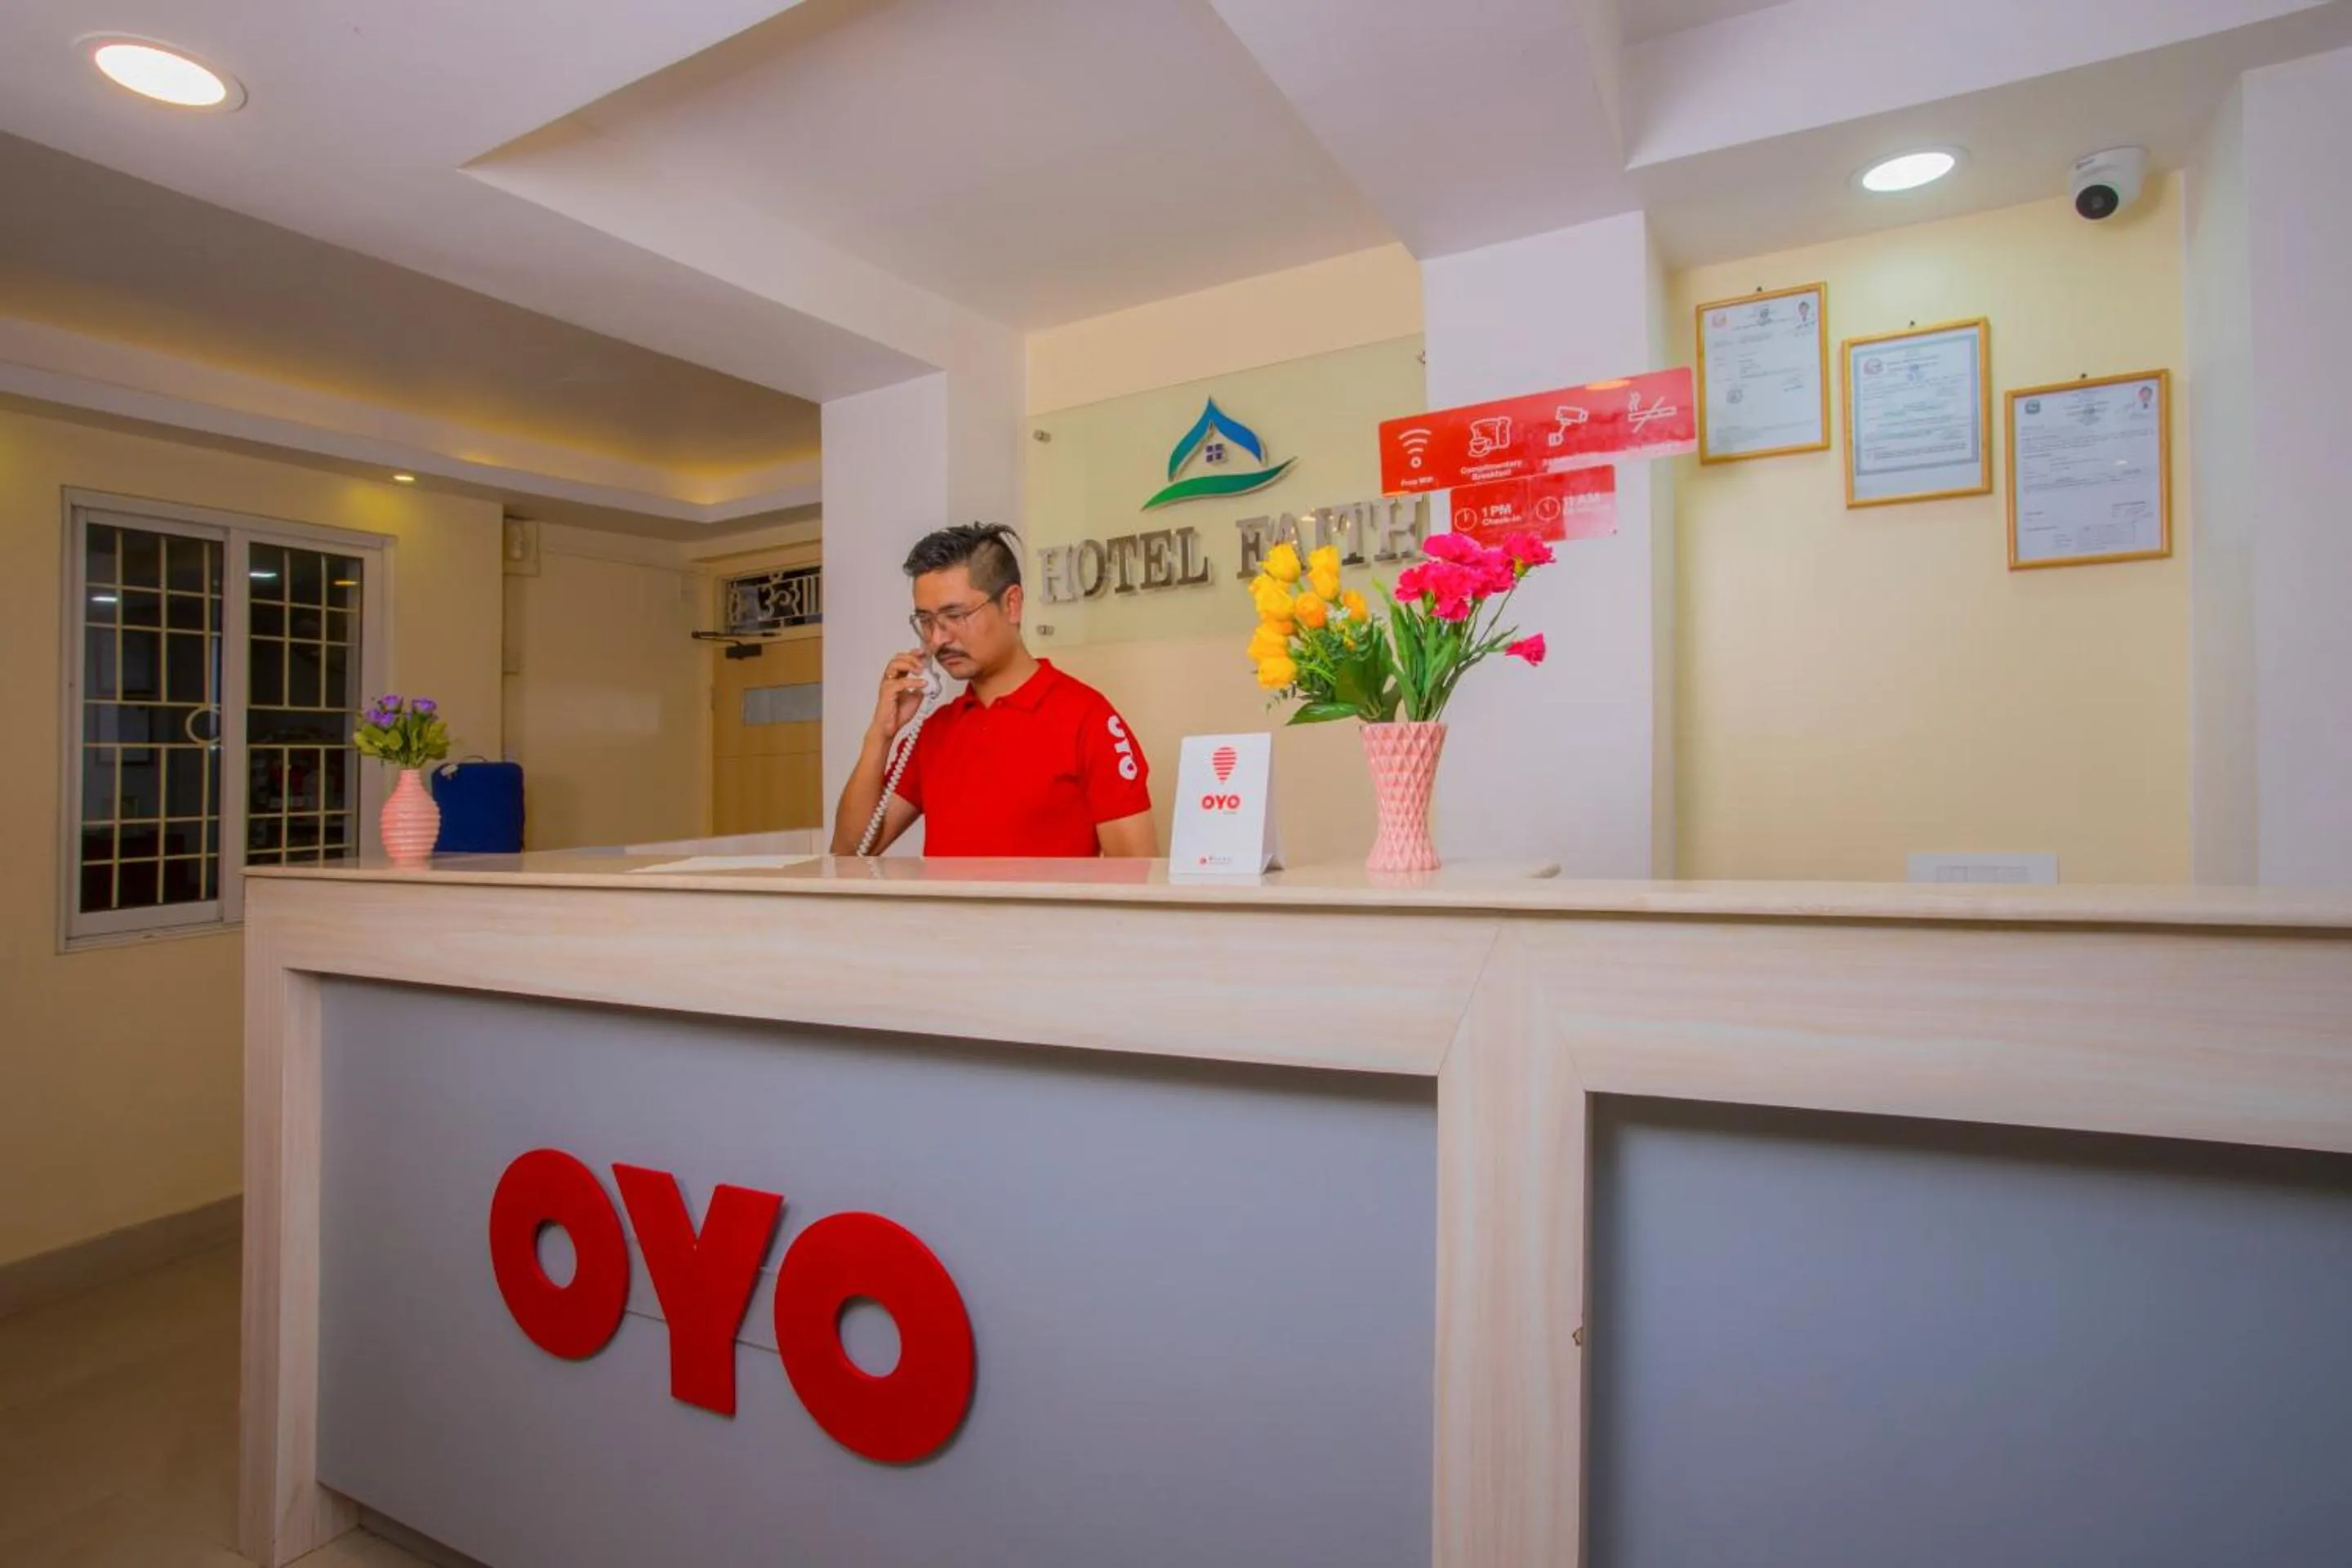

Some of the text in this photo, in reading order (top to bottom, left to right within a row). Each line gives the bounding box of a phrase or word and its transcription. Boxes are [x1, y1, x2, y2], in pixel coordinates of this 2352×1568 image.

[1577, 492, 1601, 506] AM
[1481, 503, 1512, 517] 1 PM
[1481, 514, 1523, 527] Check-in
[1038, 526, 1209, 604] HOTEL
[1201, 794, 1241, 810] OYO
[490, 1147, 975, 1463] OYO
